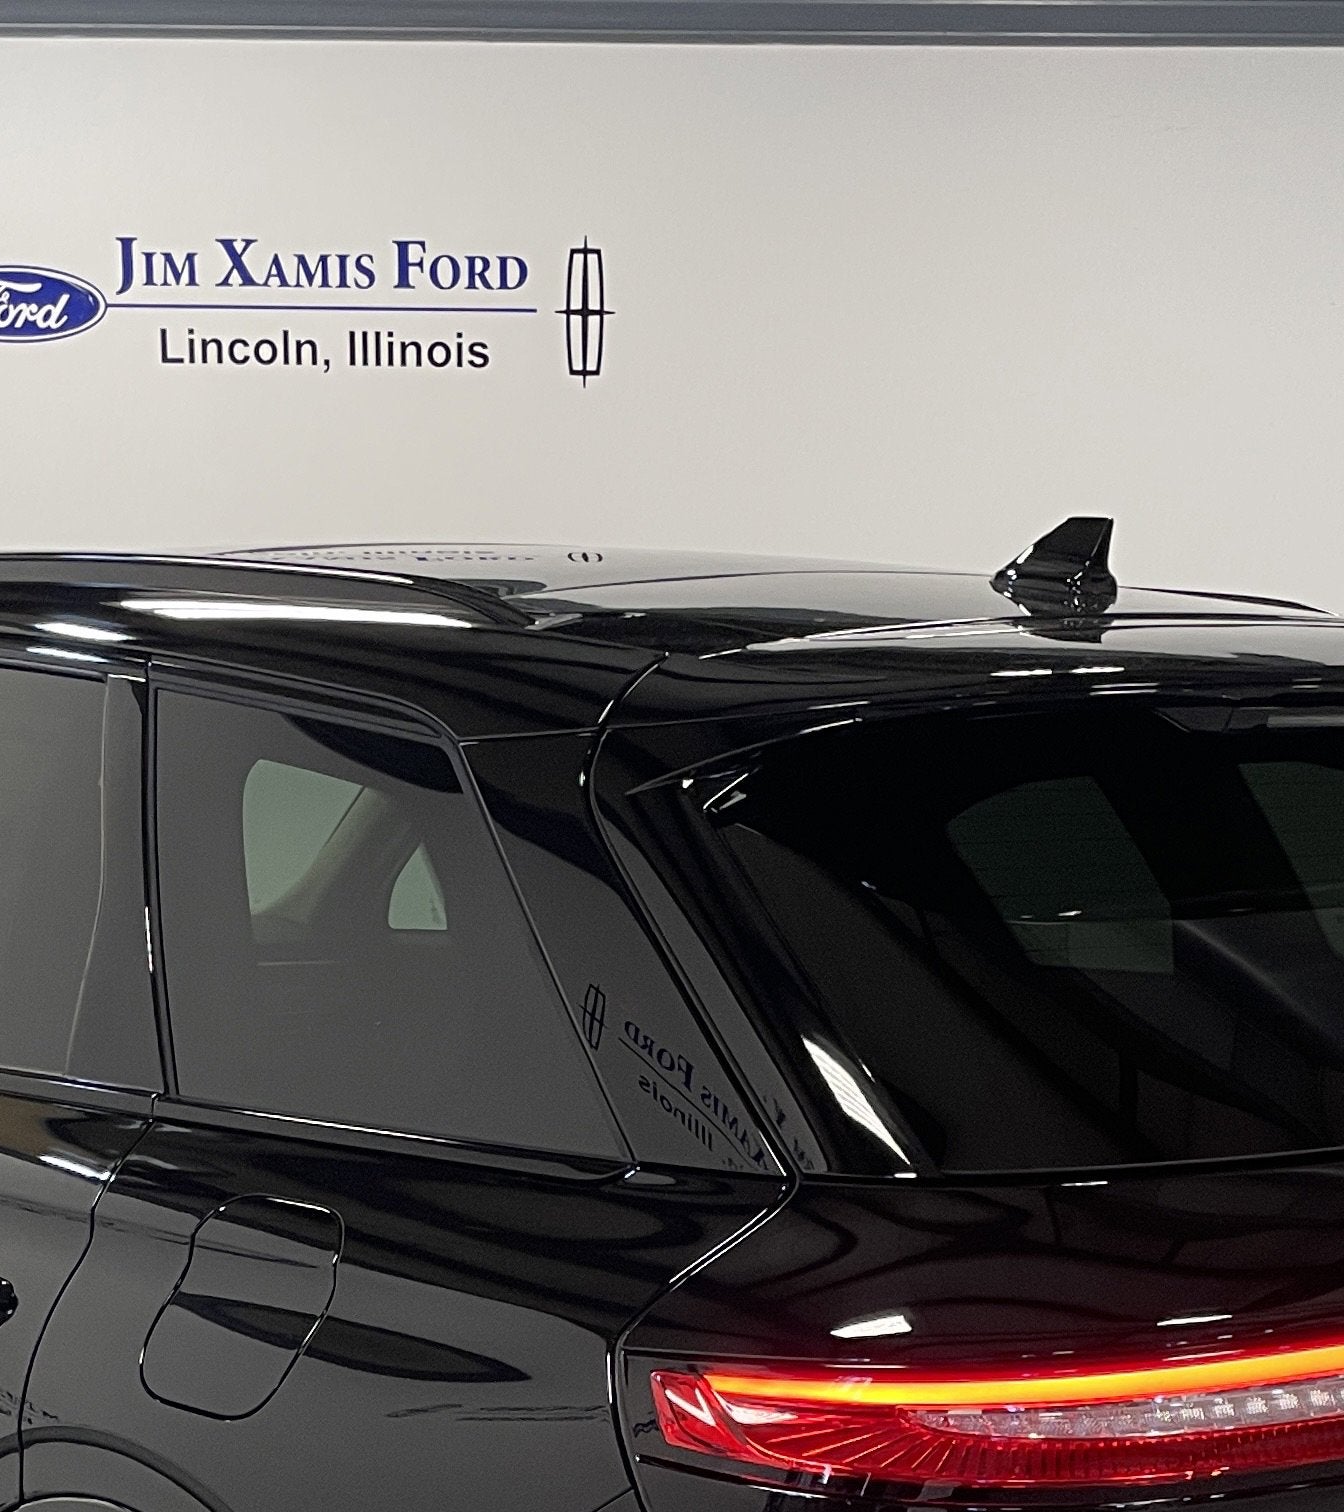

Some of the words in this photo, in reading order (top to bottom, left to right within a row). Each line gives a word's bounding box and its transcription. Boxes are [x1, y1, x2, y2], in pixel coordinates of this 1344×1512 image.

[116, 238, 199, 295] JIM
[216, 239, 375, 289] XAMIS
[393, 241, 527, 290] FORD
[161, 329, 329, 373] Lincoln,
[349, 331, 489, 368] Illinois
